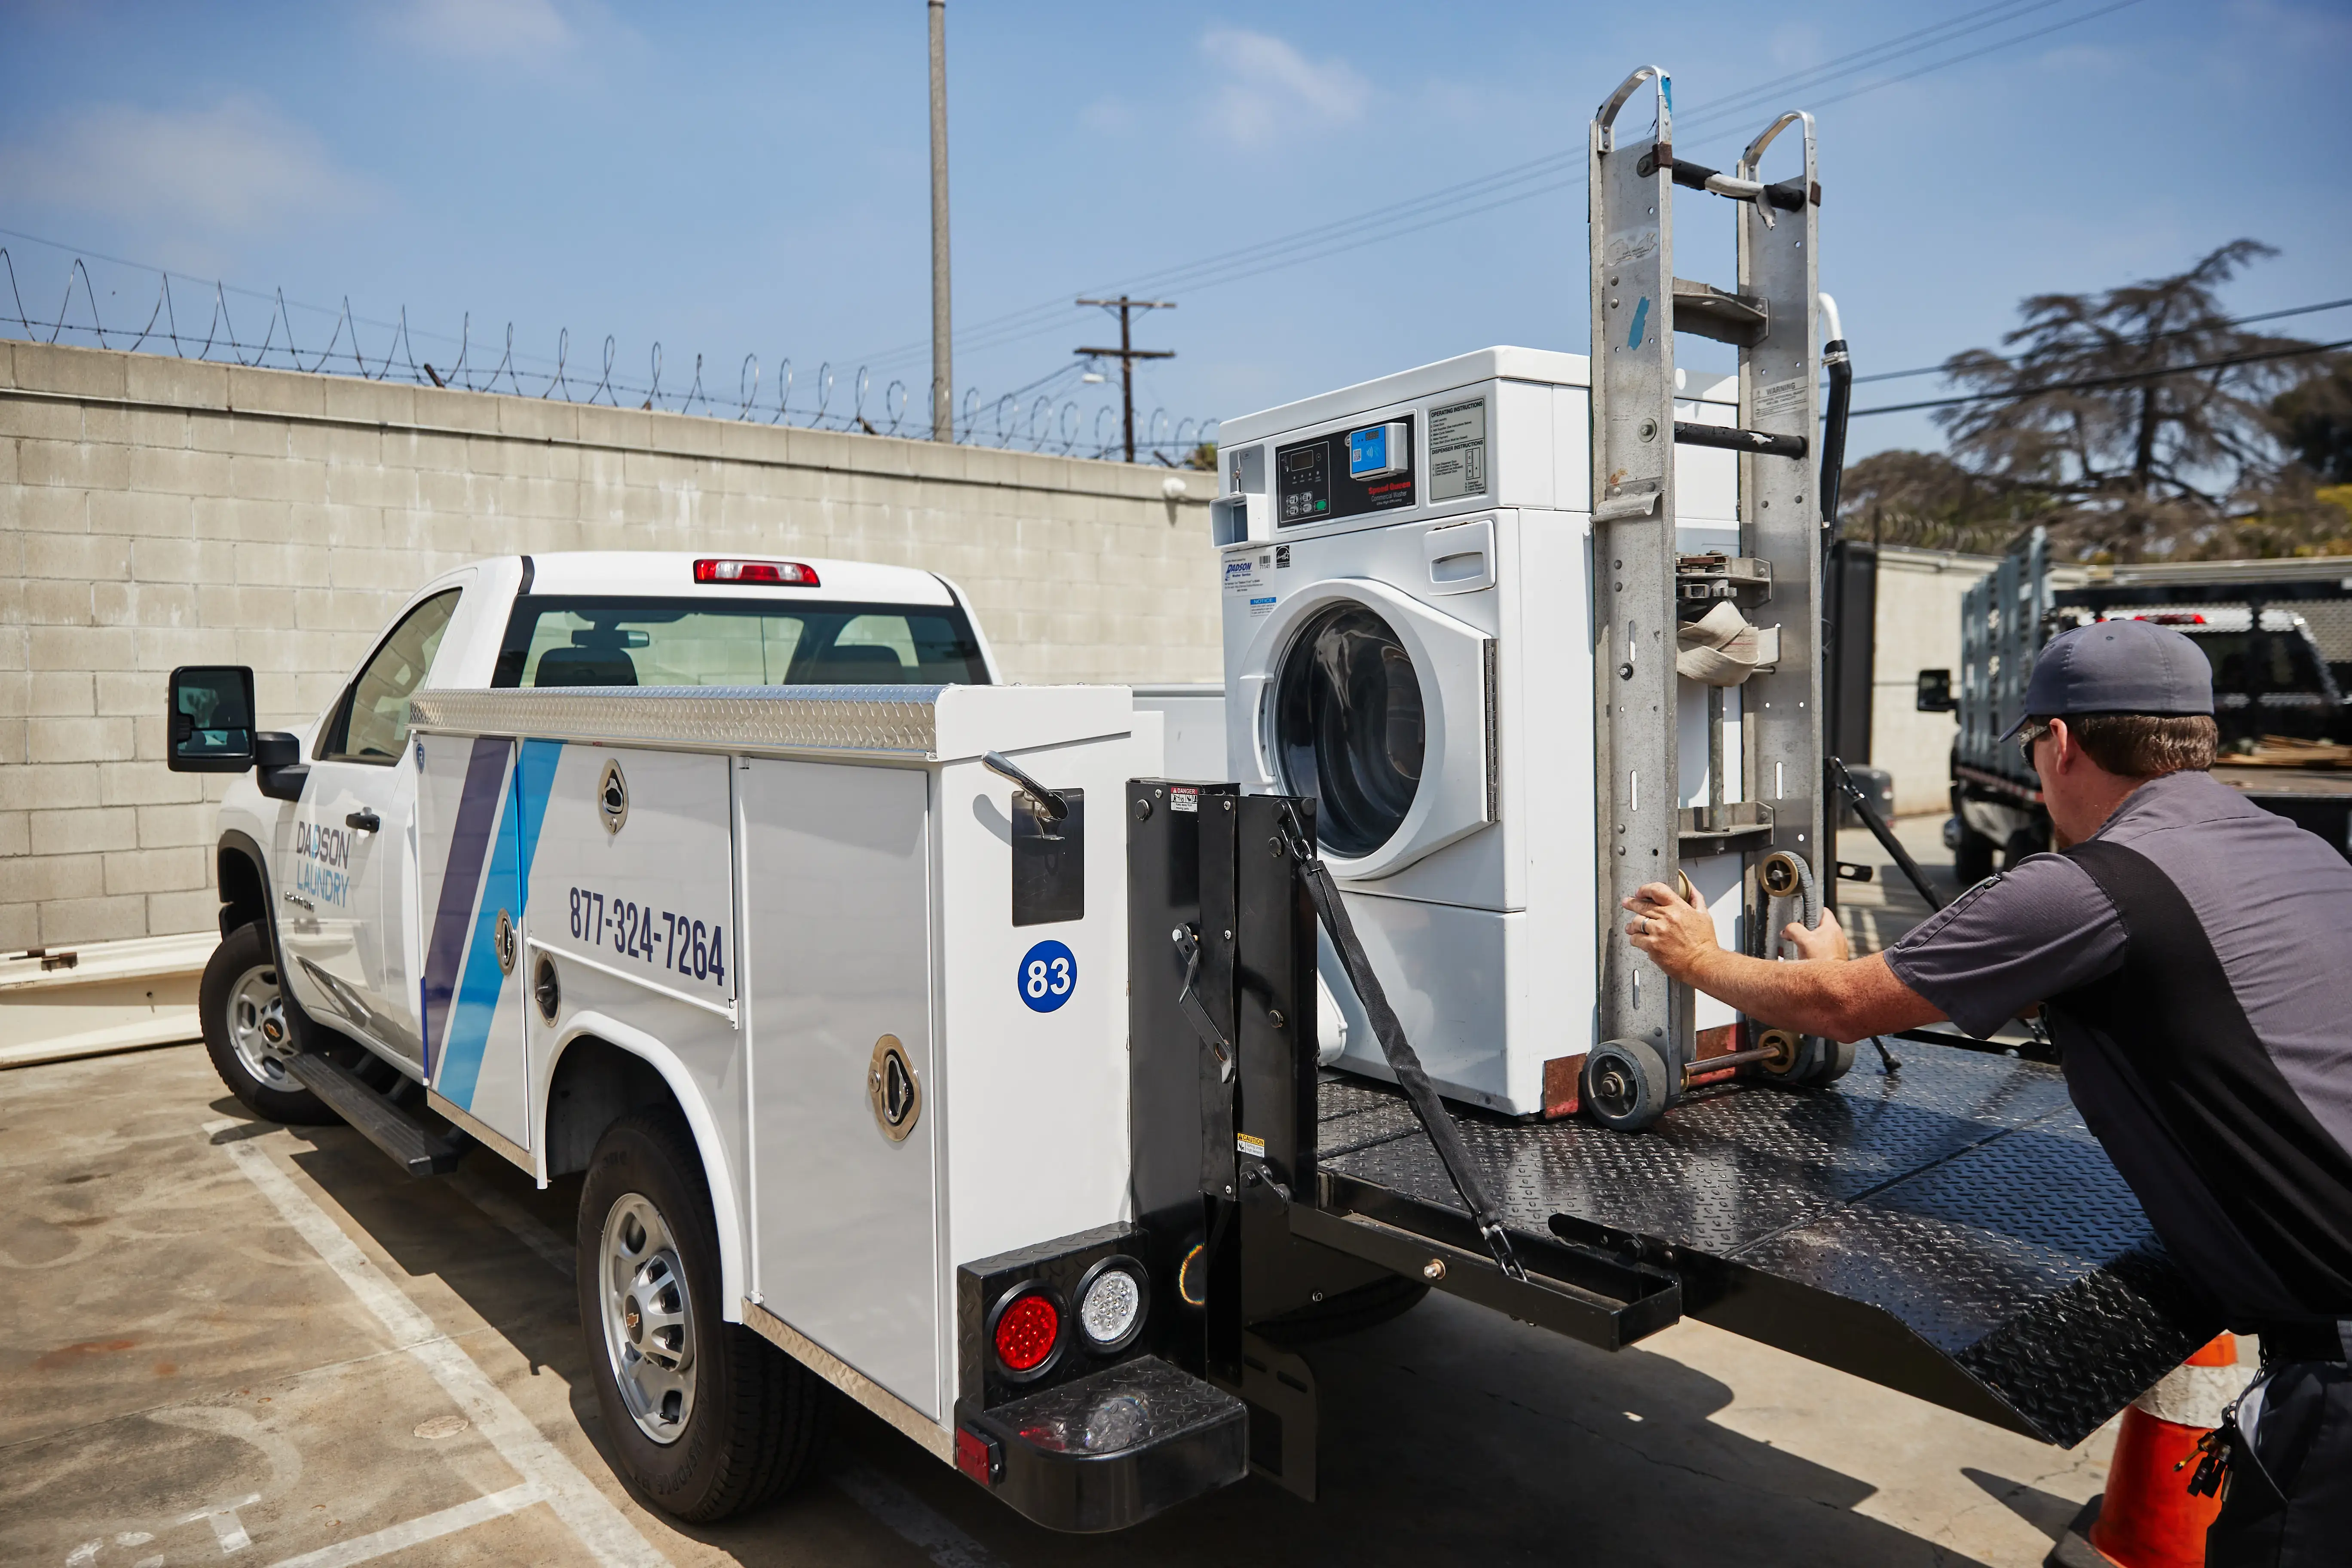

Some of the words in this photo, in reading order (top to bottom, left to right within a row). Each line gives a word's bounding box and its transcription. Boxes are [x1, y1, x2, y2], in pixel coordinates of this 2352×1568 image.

[1766, 383, 1795, 395] WARNING
[1431, 408, 1453, 417] OPERATING
[1454, 401, 1483, 412] INSTRUCTIONS
[1432, 446, 1454, 455] DISPENSER
[1454, 440, 1483, 450] INSTRUCTIONS
[1369, 484, 1389, 496] Speed
[1390, 481, 1411, 490] Queen
[1371, 493, 1392, 502] Commercial
[1227, 562, 1252, 573] DADSON
[419, 751, 423, 763] R
[297, 821, 350, 870] DADSON
[297, 860, 349, 908] LAUNDRY
[570, 887, 724, 986] 877-324-7264
[1027, 957, 1071, 998] 83
[1243, 1135, 1263, 1145] CAUTION
